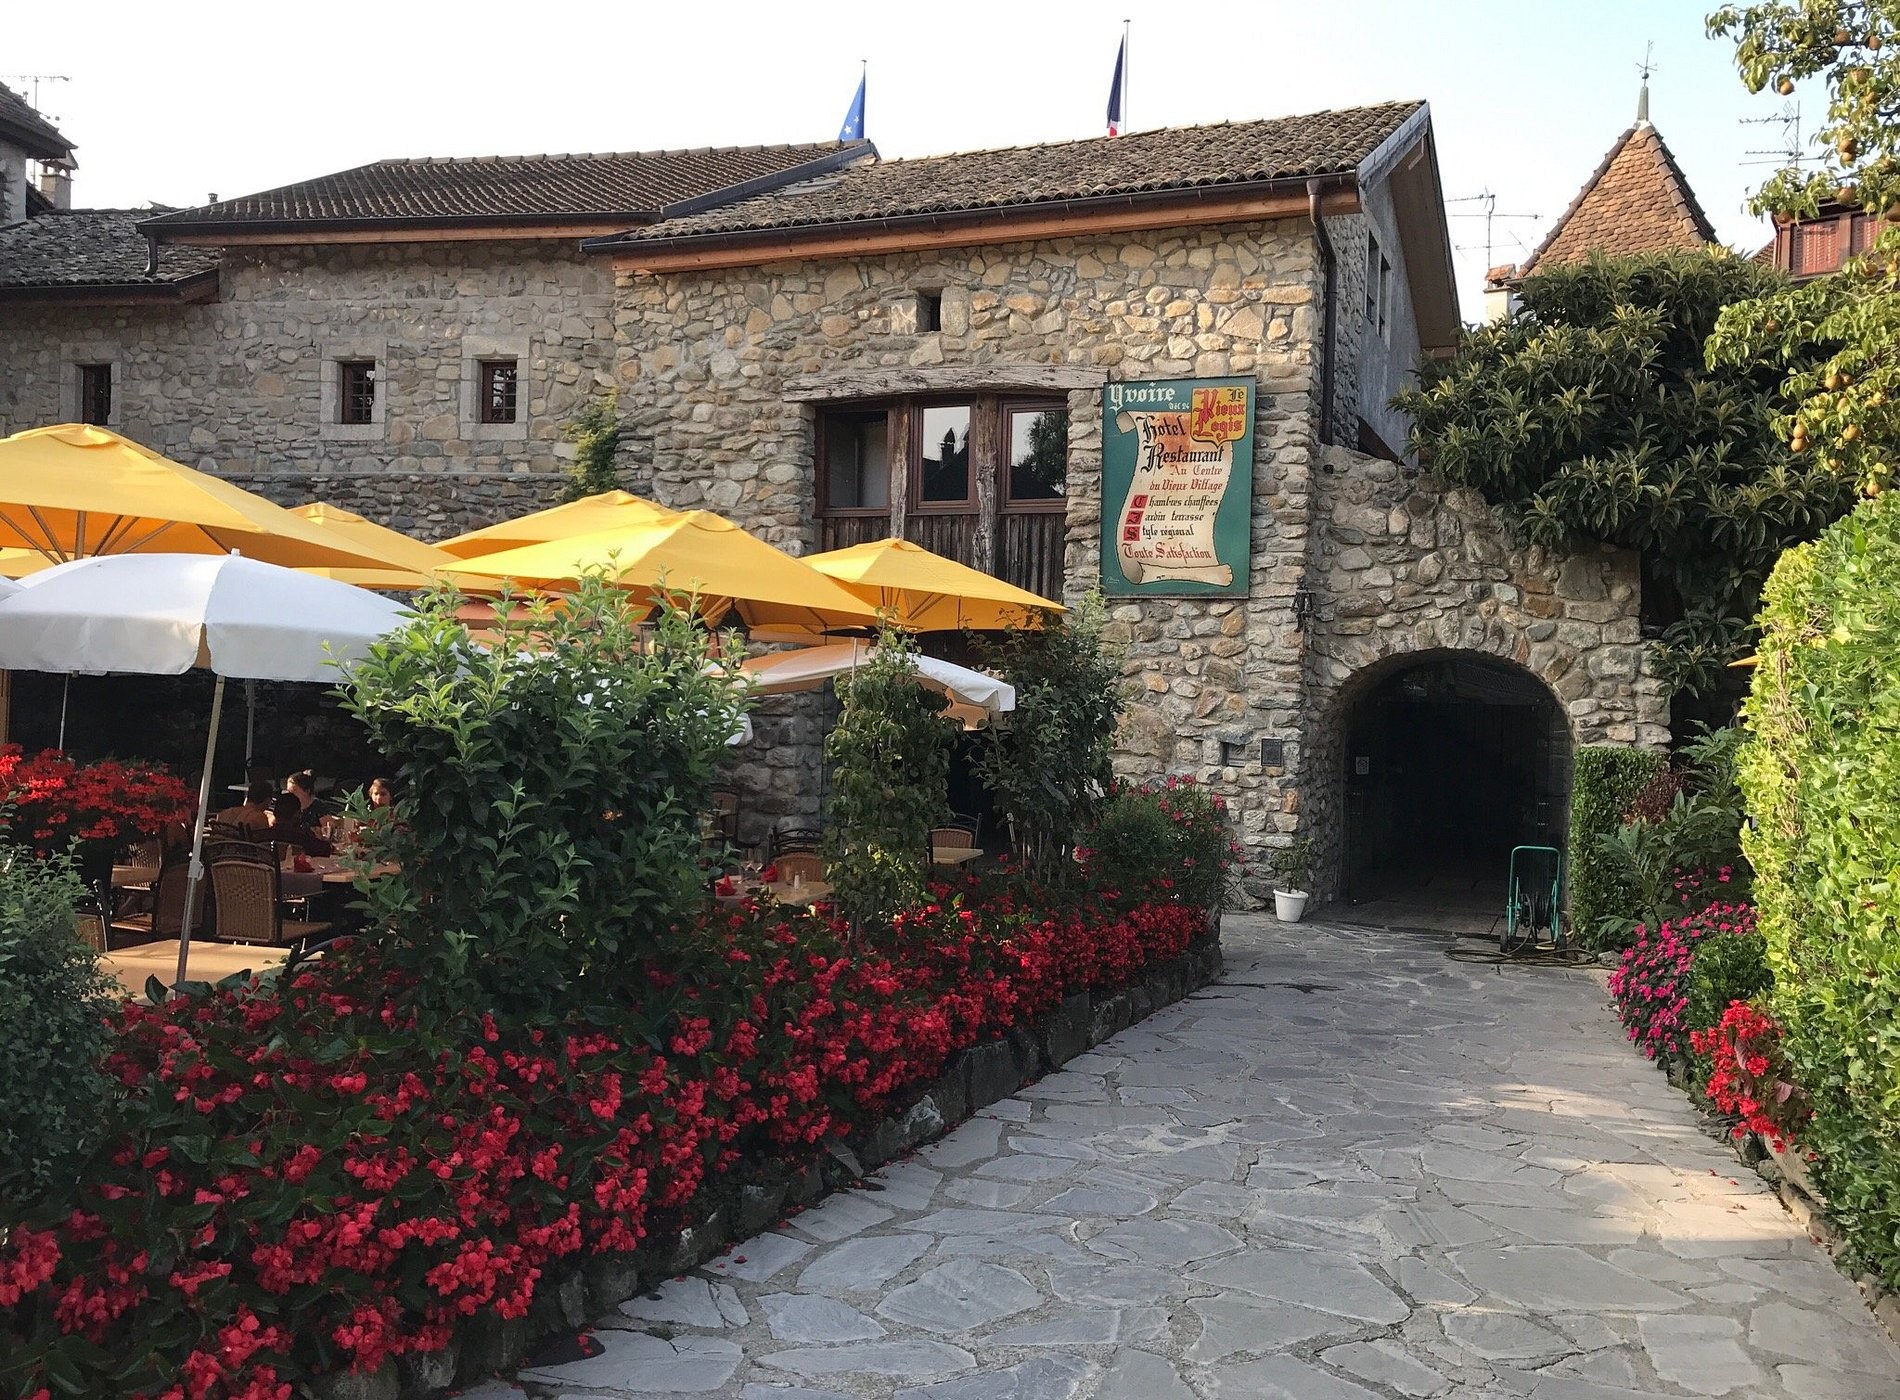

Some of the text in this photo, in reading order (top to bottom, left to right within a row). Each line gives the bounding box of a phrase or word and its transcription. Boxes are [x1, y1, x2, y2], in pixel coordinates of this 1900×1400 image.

[1109, 382, 1176, 411] Yvoire
[1194, 389, 1245, 424] Vieux
[1227, 388, 1244, 402] Le
[1193, 408, 1242, 442] Logis
[1140, 443, 1224, 473] Restaurant
[1170, 464, 1222, 475] Au Centre
[1150, 481, 1160, 490] du
[1190, 479, 1223, 493] Village
[1171, 510, 1204, 521] terrasse
[1121, 541, 1212, 564] Toute Satisfaction
